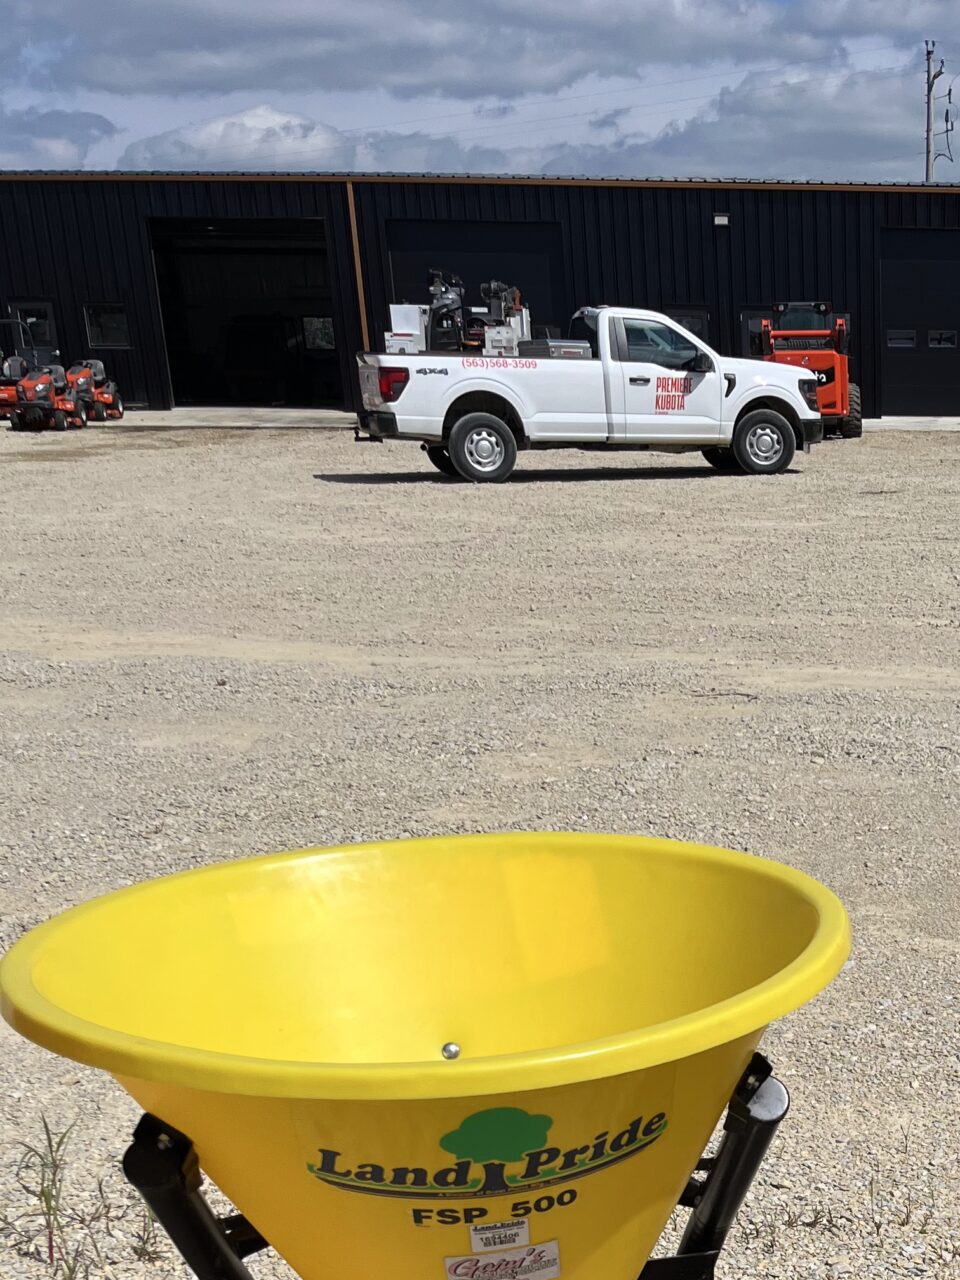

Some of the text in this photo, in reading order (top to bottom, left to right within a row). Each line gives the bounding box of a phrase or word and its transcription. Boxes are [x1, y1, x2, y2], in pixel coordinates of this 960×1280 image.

[461, 359, 538, 369] (563)568-3509
[656, 377, 693, 394] PREMIERE
[655, 395, 685, 411] KUBOTA
[316, 1111, 667, 1188] Land Pride
[412, 1189, 578, 1225] FSP 500
